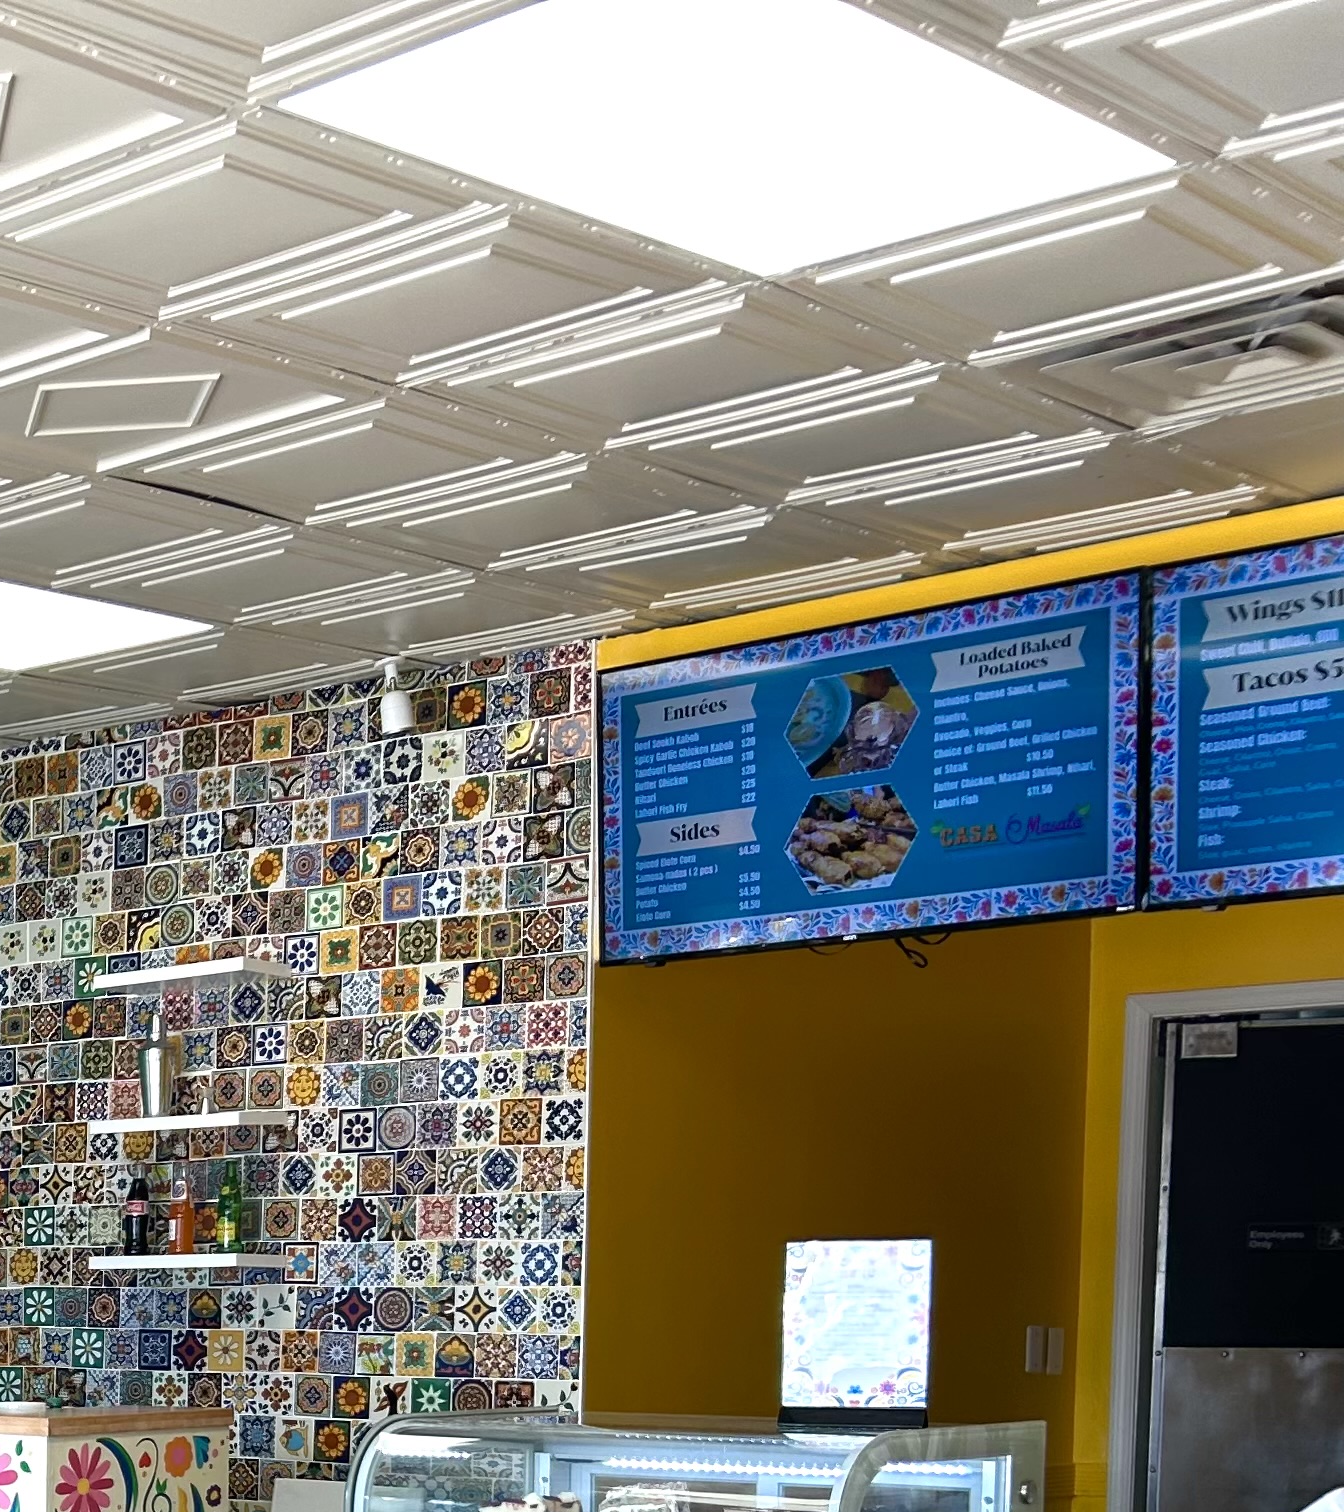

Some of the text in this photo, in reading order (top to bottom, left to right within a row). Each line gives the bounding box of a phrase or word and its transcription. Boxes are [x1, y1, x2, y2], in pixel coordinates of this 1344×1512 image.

[1225, 598, 1306, 623] Wings
[960, 633, 1072, 666] Loaded Baked
[978, 656, 1049, 678] Potatoes
[1232, 667, 1309, 693] Tacos
[664, 698, 727, 721] Entrées
[1200, 706, 1255, 726] Seasoned
[1257, 700, 1299, 717] Ground
[1199, 735, 1255, 754] Seasoned
[669, 822, 721, 843] Sides
[940, 823, 998, 847] CASA
